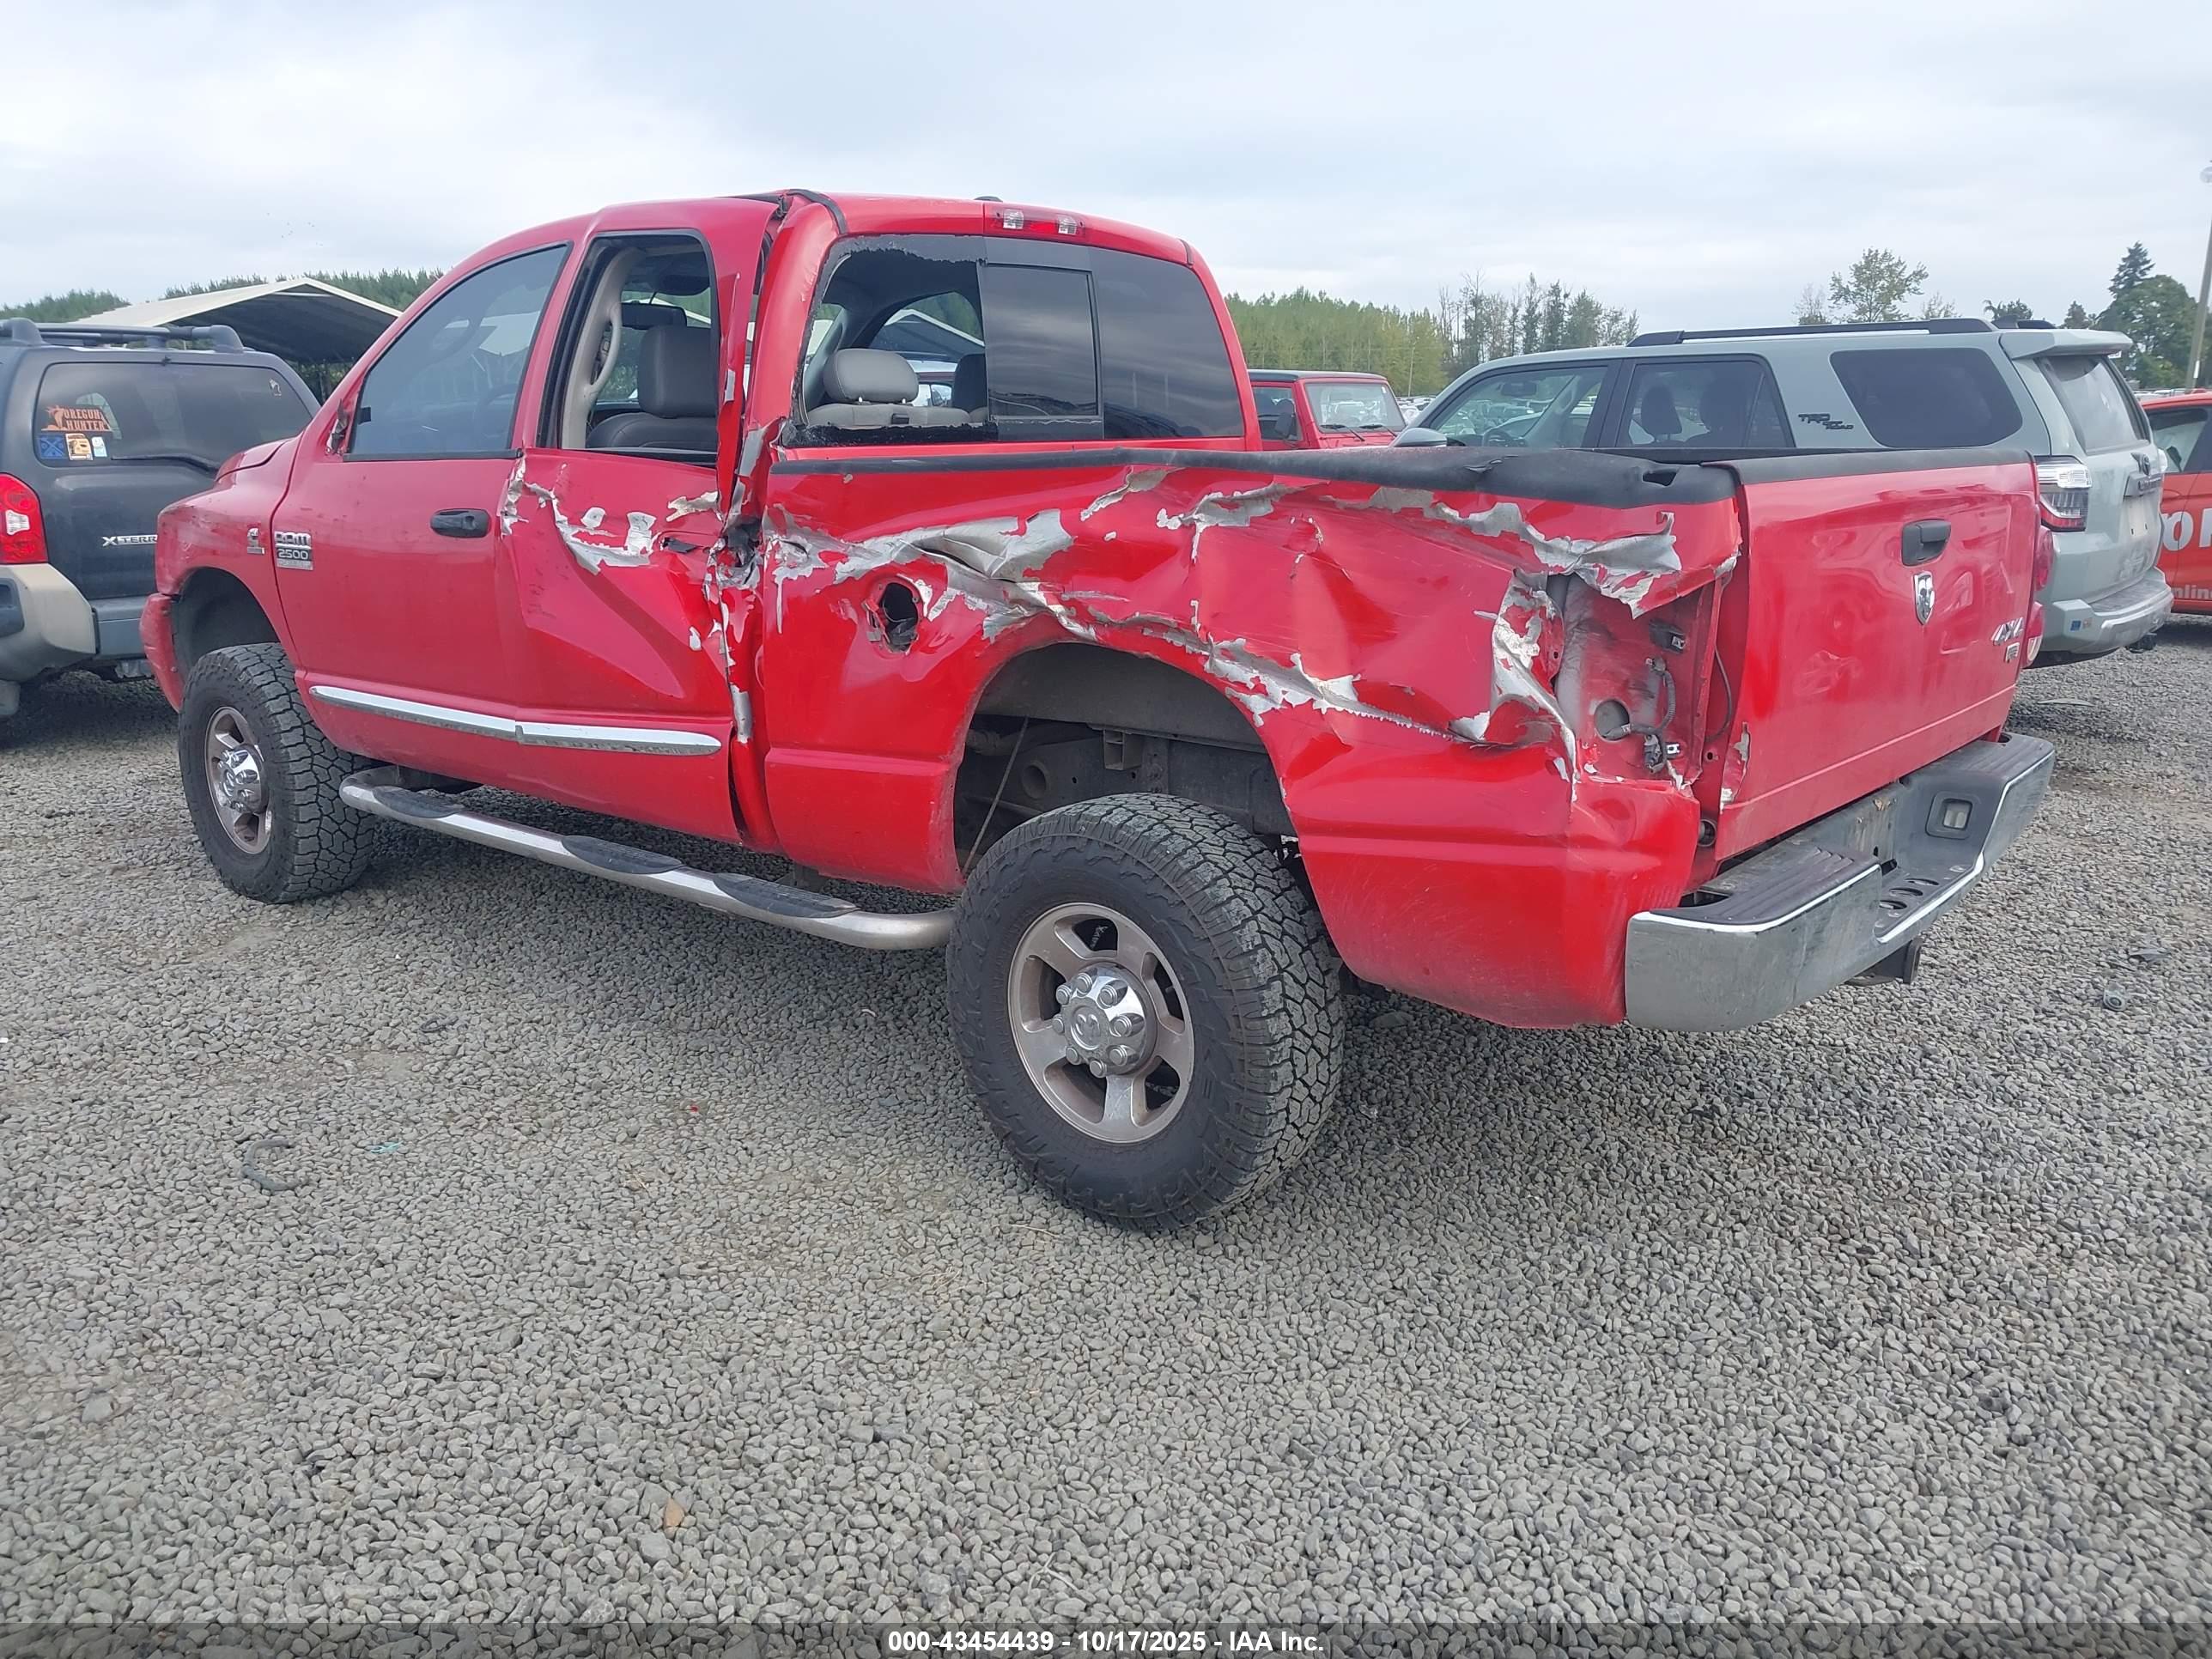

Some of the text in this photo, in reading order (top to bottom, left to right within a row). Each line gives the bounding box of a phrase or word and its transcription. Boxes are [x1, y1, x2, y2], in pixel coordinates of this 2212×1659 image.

[66, 420, 106, 430] HUNTER
[275, 531, 312, 550] RAM
[277, 549, 309, 561] 2500
